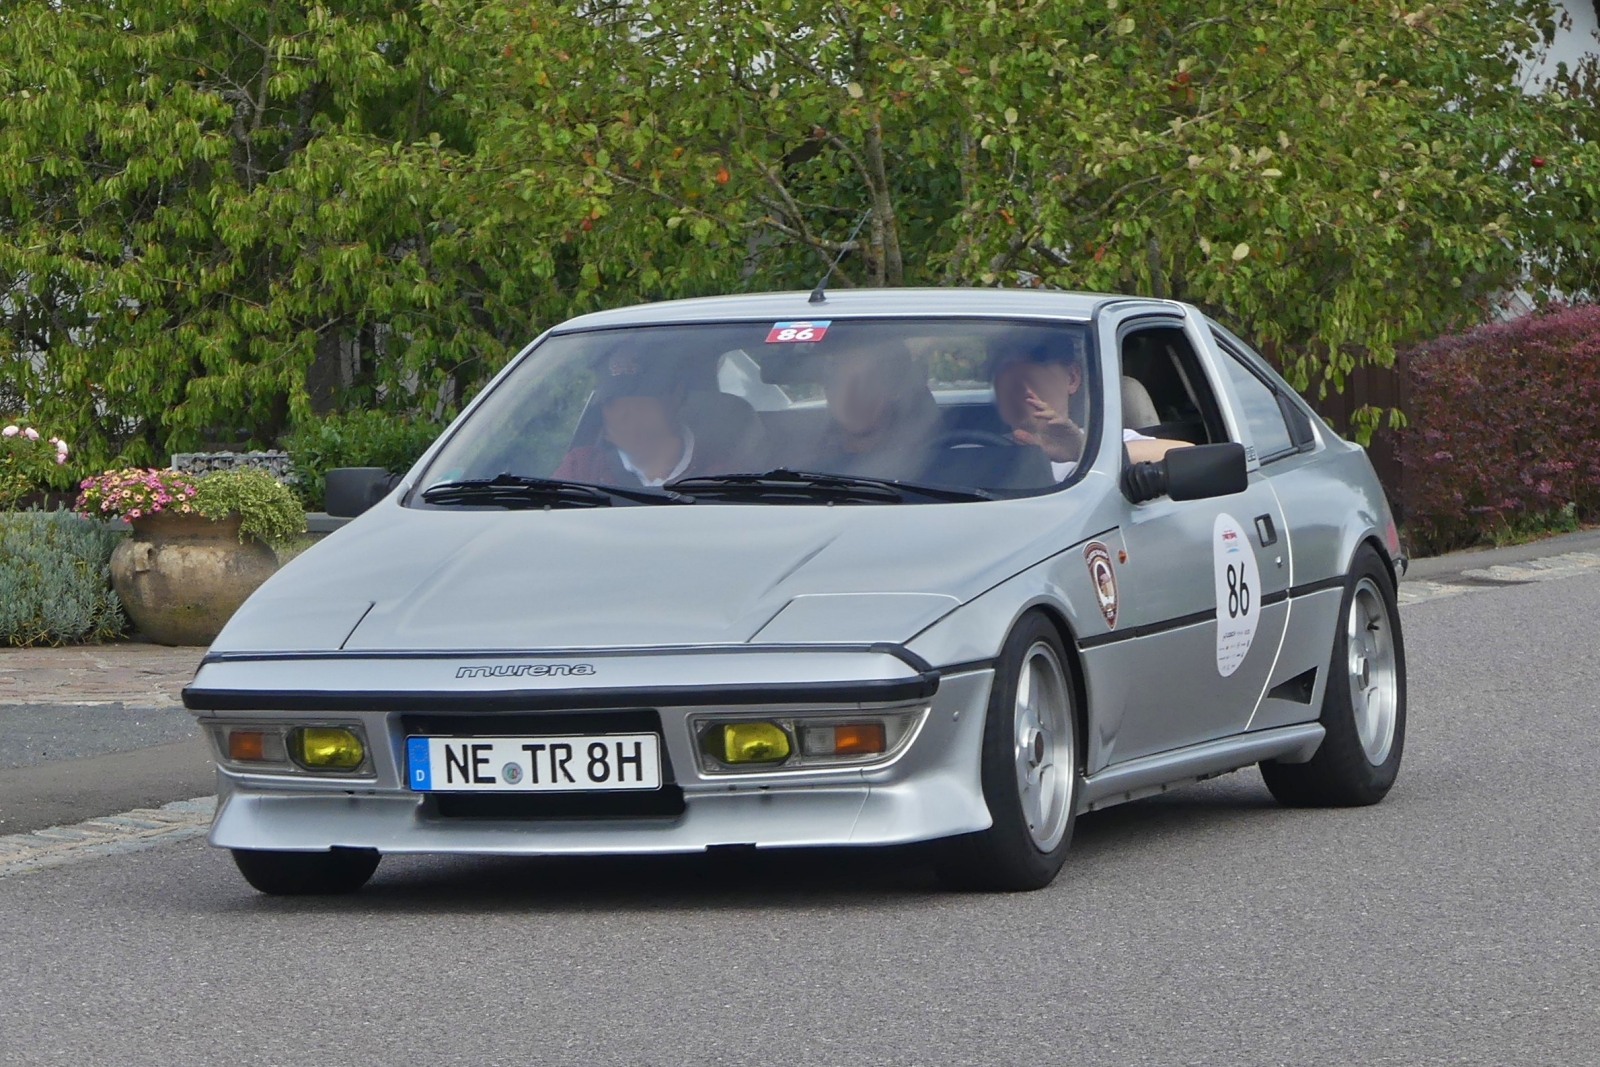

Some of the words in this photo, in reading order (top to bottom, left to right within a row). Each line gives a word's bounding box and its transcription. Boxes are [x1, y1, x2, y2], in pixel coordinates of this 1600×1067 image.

[777, 328, 814, 341] 86
[1227, 561, 1250, 619] 86
[455, 664, 596, 679] murena
[416, 770, 425, 782] D
[445, 744, 496, 784] NE
[522, 743, 576, 784] TR
[587, 741, 643, 783] 8H
